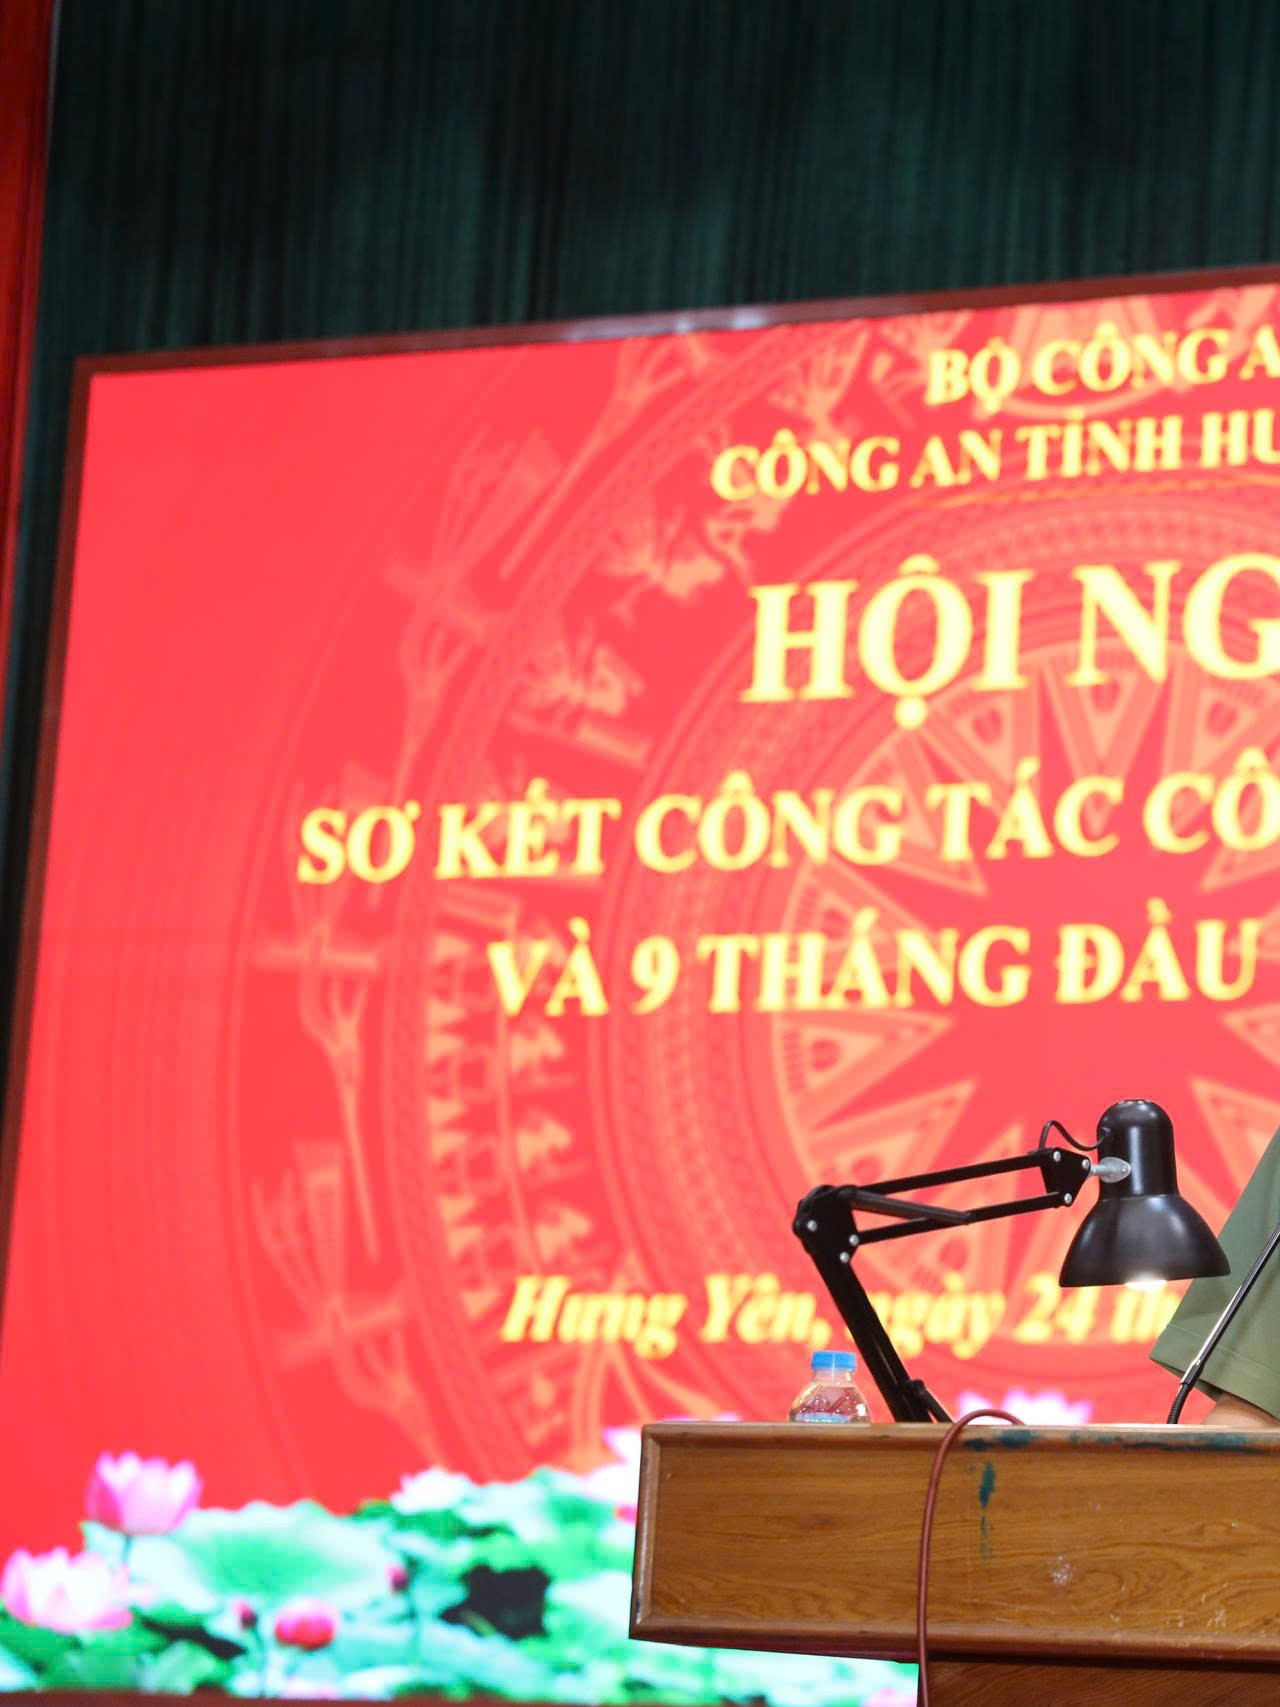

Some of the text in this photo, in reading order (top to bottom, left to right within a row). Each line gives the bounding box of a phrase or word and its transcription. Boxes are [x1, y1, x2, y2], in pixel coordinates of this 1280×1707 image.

[925, 339, 1023, 415] BỘ
[1029, 318, 1232, 395] CÔNG
[710, 429, 900, 501] CÔNG
[911, 430, 1002, 487] AN
[1016, 406, 1183, 481] TỈNH
[744, 554, 1032, 731] HỘI
[297, 801, 420, 884] SƠ
[435, 778, 622, 880] KẾT
[635, 770, 908, 873] CÔNG
[925, 756, 1125, 863] TÁC
[487, 918, 608, 1016] VÀ
[631, 936, 680, 1013] 9
[696, 906, 1030, 1013] THÁNG
[1056, 898, 1263, 1004] ĐẦU
[702, 1273, 832, 1350] Yên,
[1012, 1271, 1102, 1344] 24
